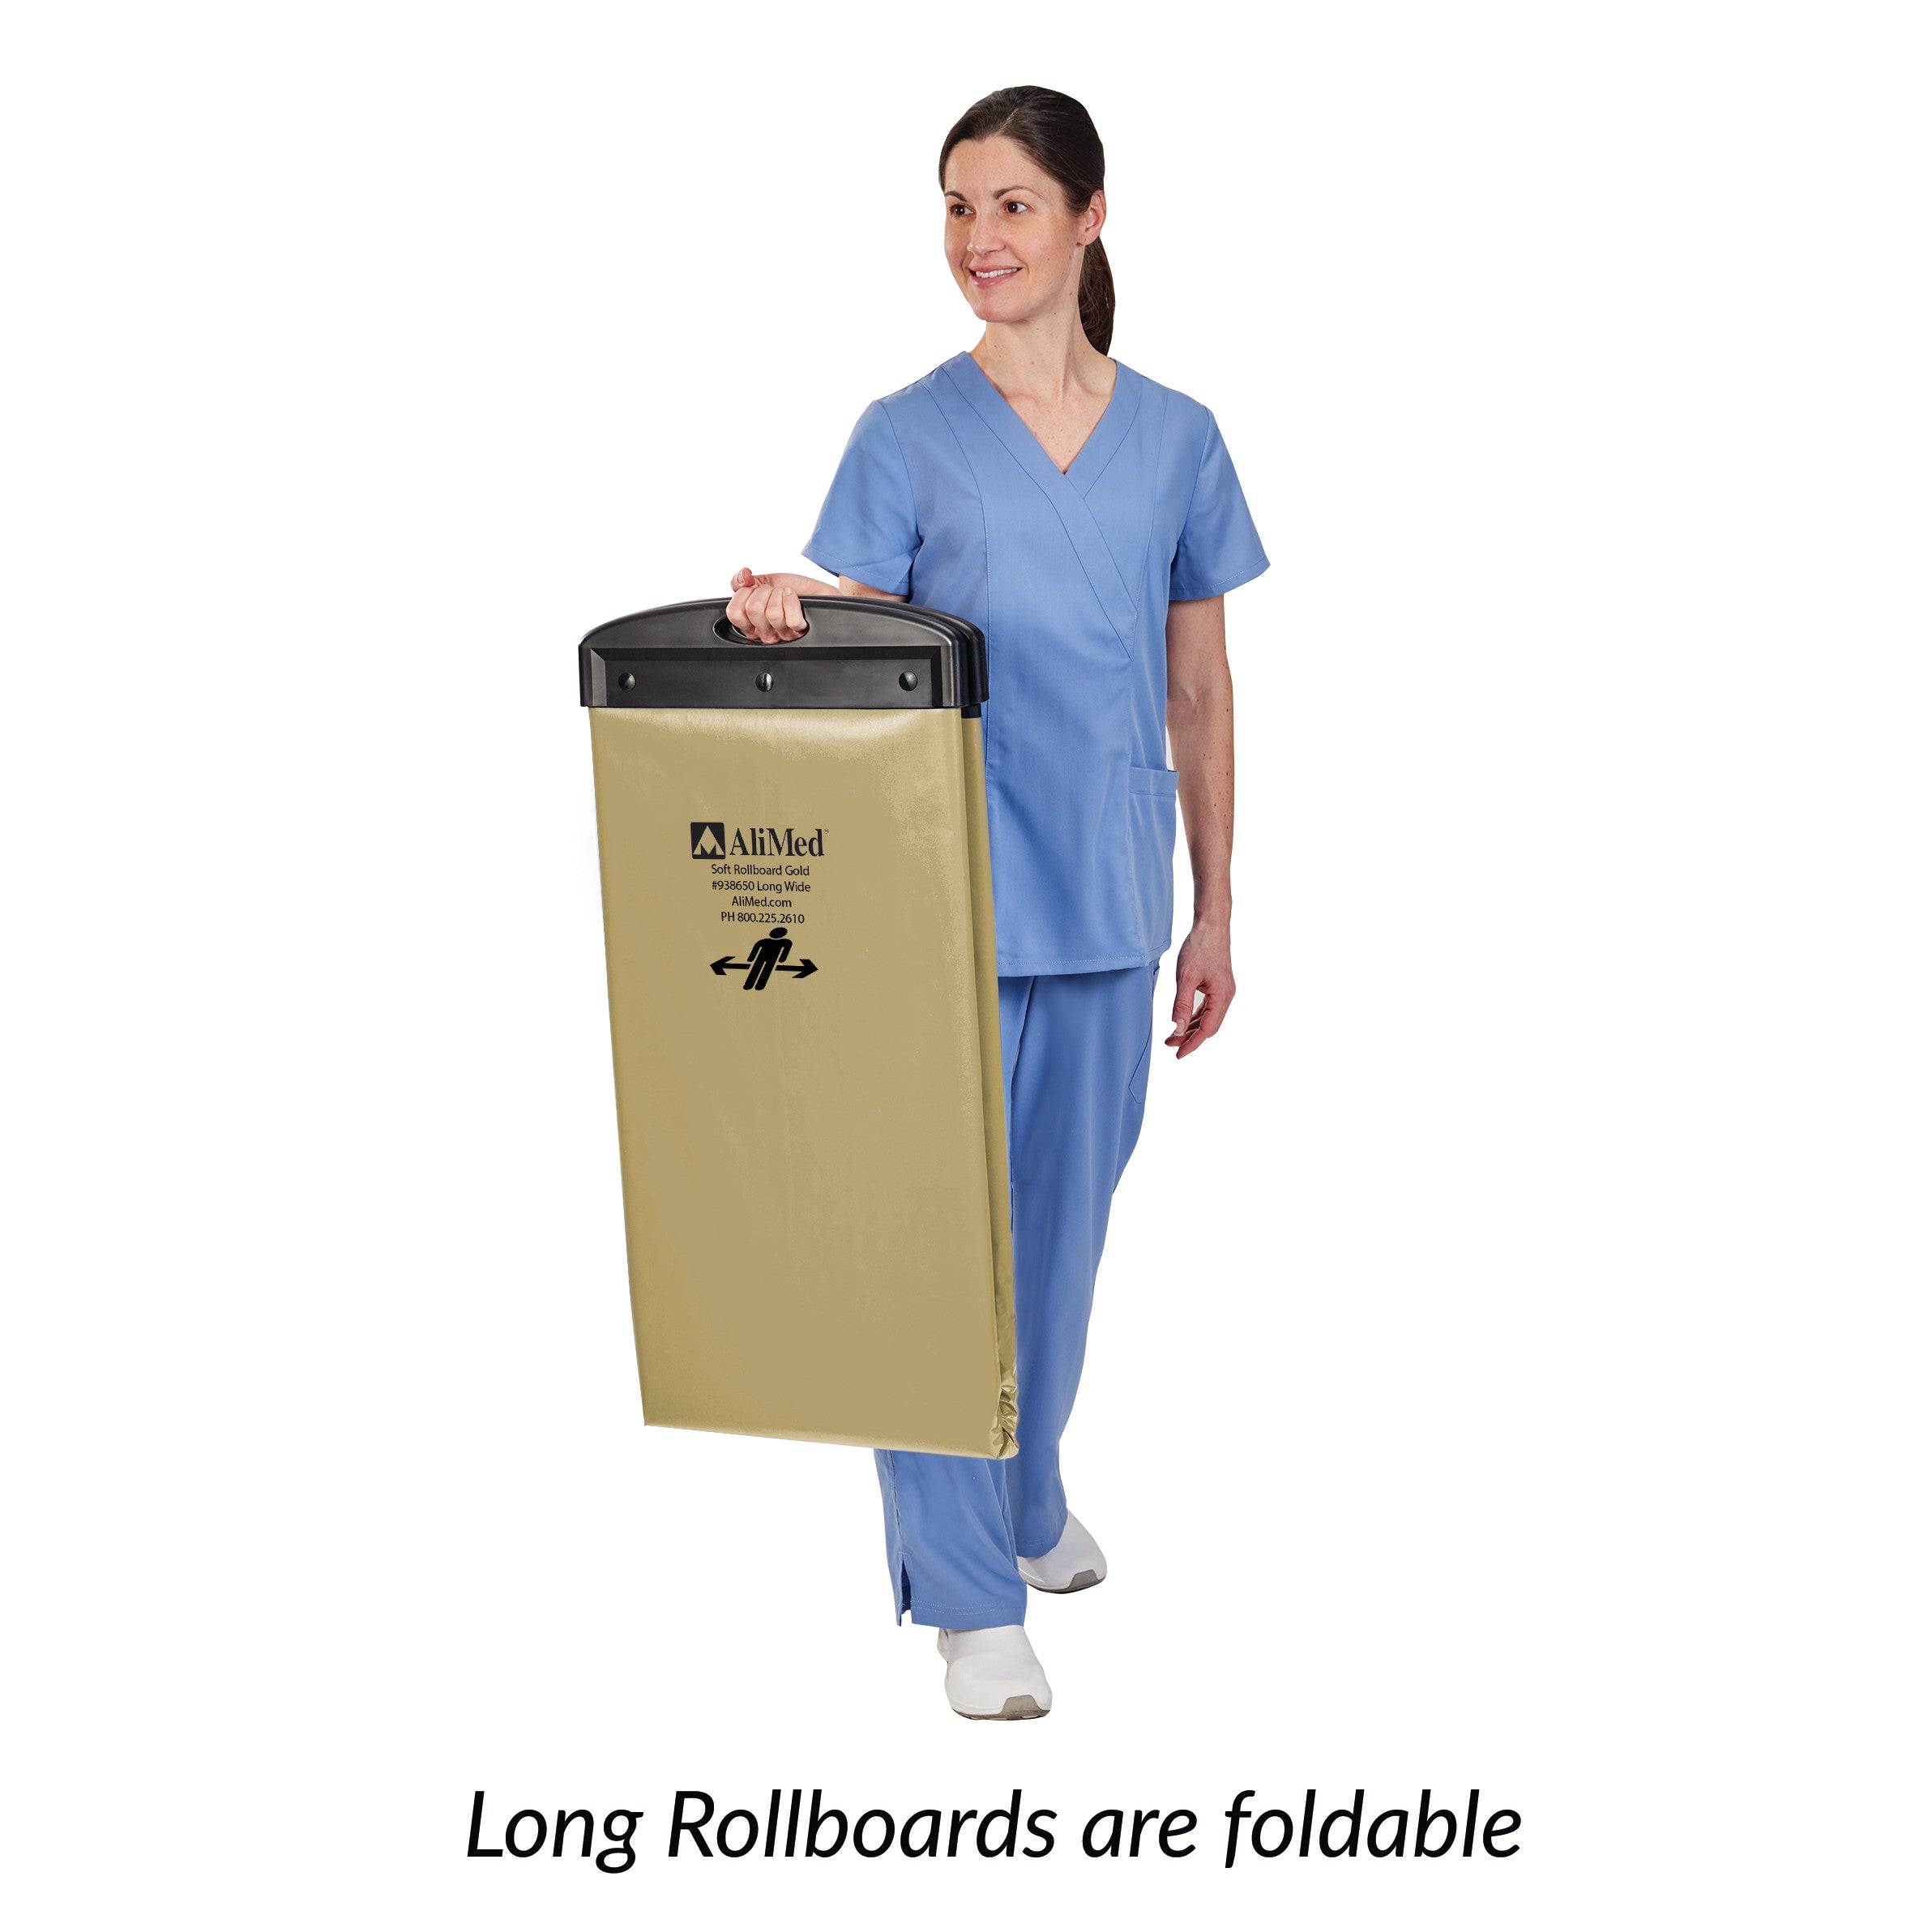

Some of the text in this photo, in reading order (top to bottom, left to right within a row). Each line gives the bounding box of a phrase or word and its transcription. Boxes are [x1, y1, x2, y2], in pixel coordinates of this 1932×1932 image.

[729, 827, 825, 857] AliMed
[711, 863, 810, 876] Soft Rollboard Gold
[712, 880, 811, 894] #938650 Long Wide
[731, 895, 792, 908] AliMed.com
[720, 911, 805, 924] PH 800.225.2610
